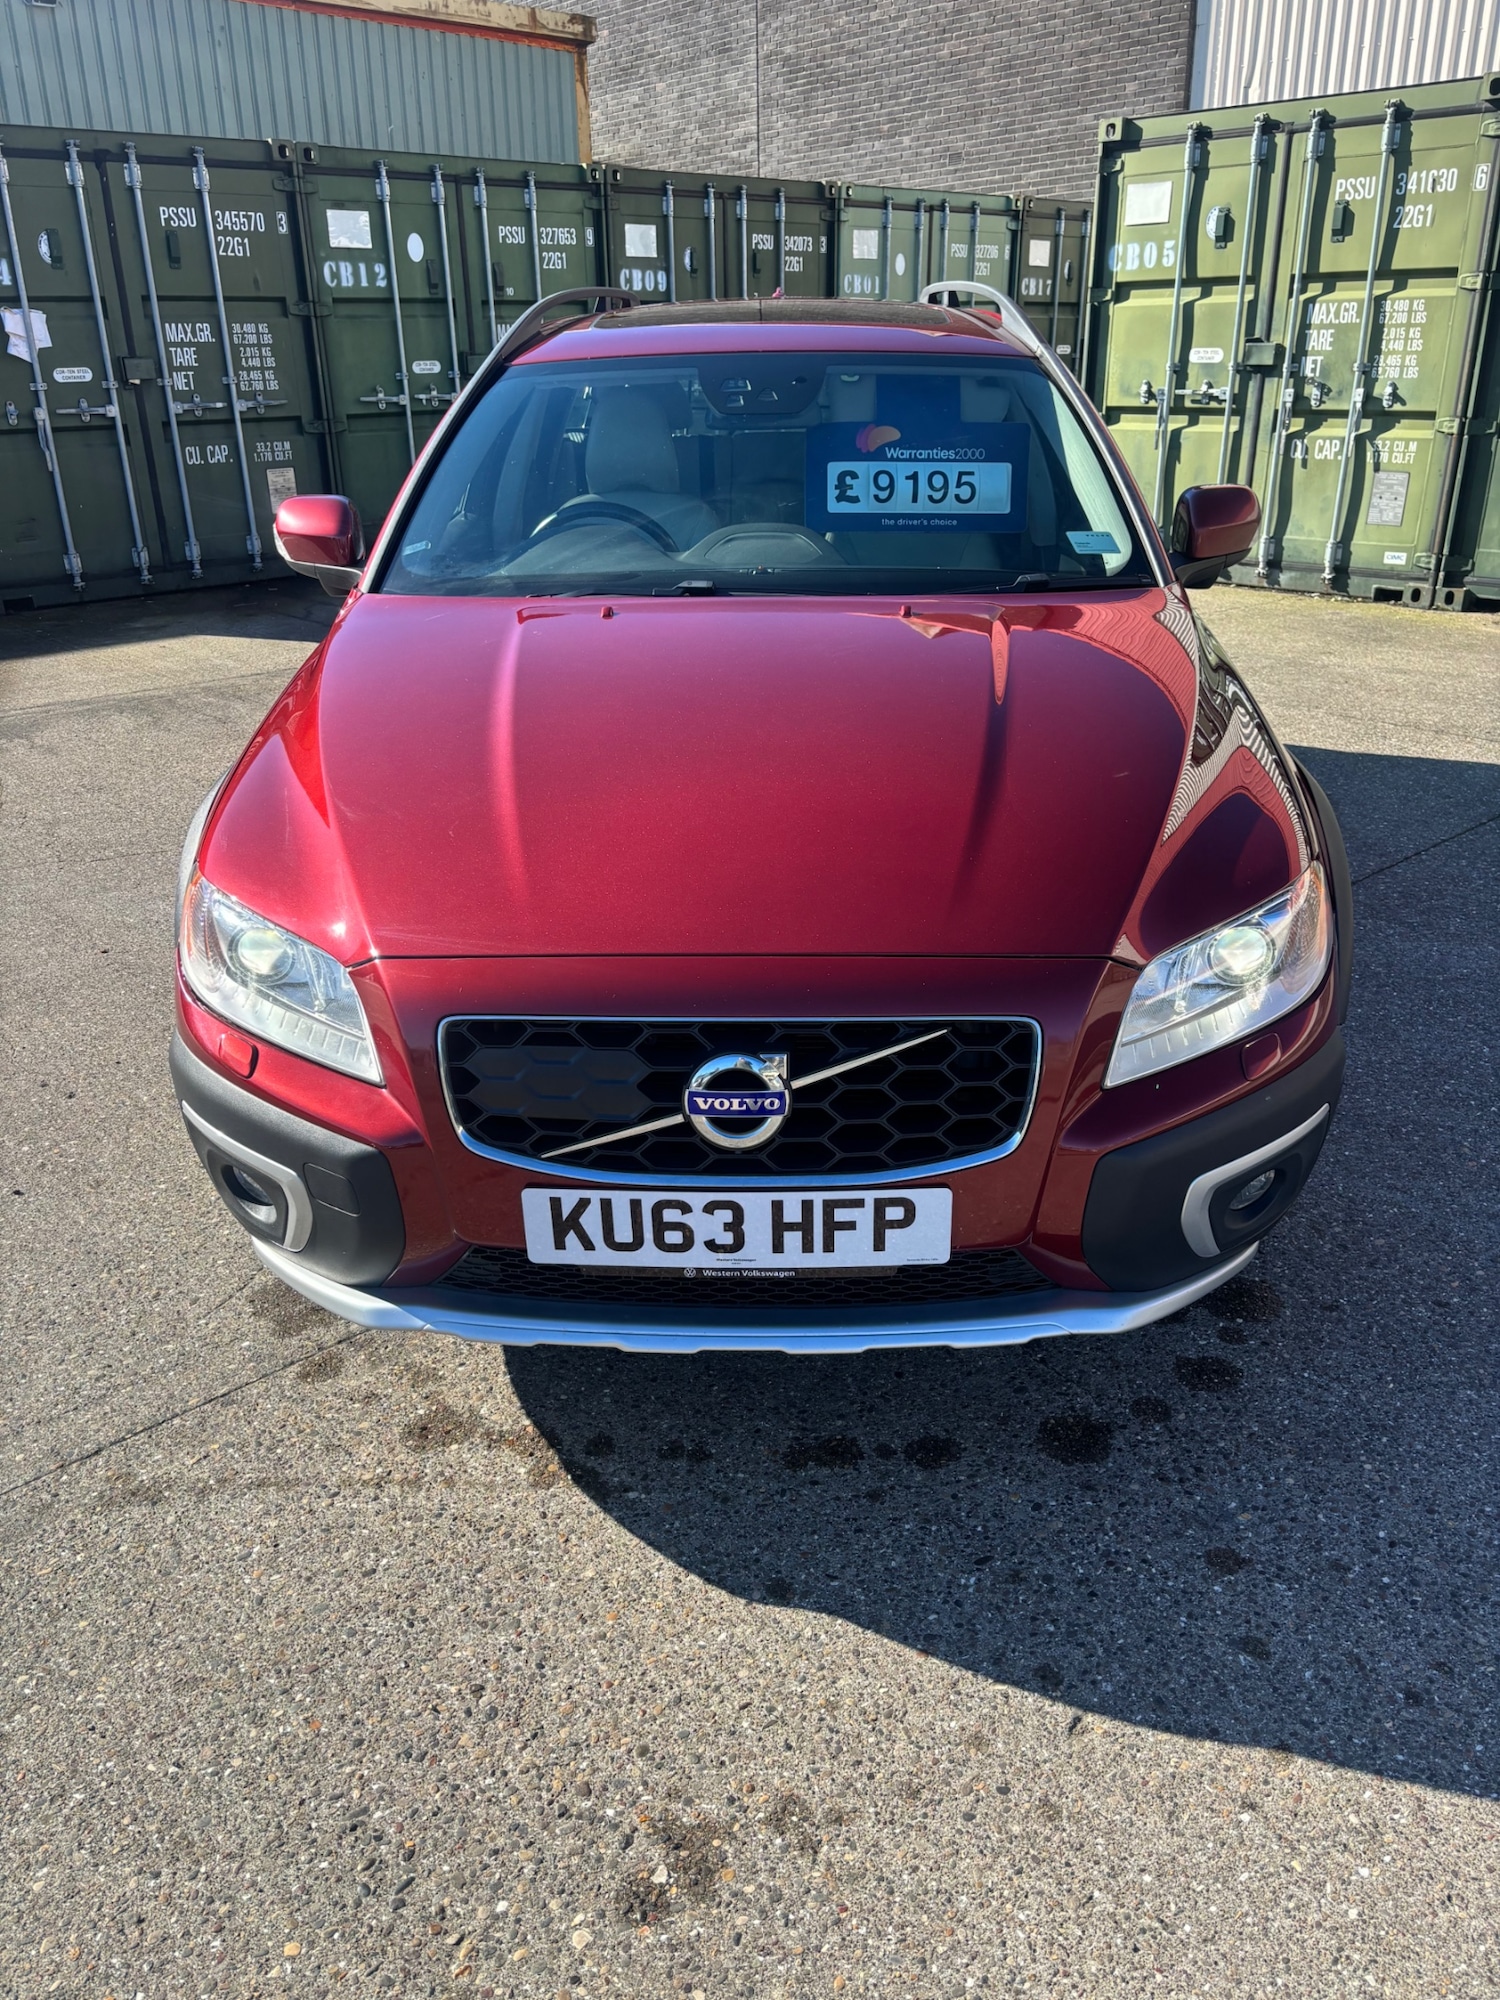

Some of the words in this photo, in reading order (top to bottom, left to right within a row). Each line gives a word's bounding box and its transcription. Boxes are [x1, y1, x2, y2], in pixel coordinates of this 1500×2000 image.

[1335, 176, 1376, 200] PSSU
[1475, 165, 1489, 190] 6
[159, 206, 197, 228] PSSU
[215, 210, 265, 232] 345570
[277, 211, 288, 234] 3
[1393, 204, 1434, 228] 22G1
[498, 225, 526, 244] PSSU
[540, 227, 577, 245] 327653
[586, 228, 594, 246] 9
[752, 233, 774, 250] PSSU
[785, 235, 813, 251] 342073
[820, 236, 827, 253] 3
[218, 235, 250, 257] 22G1
[950, 243, 968, 258] PSSU
[1108, 240, 1176, 272] CB05
[542, 251, 567, 269] 22G1
[785, 256, 804, 272] 22G1
[323, 261, 387, 288] CB12
[619, 268, 668, 292] CB09
[843, 274, 880, 295] CB01
[1021, 277, 1052, 297] CB17
[1307, 301, 1360, 324] MAX.GR.
[1413, 299, 1425, 311] KG
[1411, 312, 1427, 324] LBS
[165, 322, 215, 343] MAX.GR.
[258, 323, 269, 333] KG
[260, 334, 273, 344] LBS
[1305, 329, 1335, 351] TARE
[1409, 327, 1421, 339] KG
[1407, 340, 1423, 352] LBS
[169, 347, 199, 367] TARE
[261, 347, 272, 357] KG
[263, 357, 276, 367] LBS
[1300, 356, 1324, 378] NET
[1405, 354, 1417, 366] KG
[172, 371, 195, 391] NET
[264, 370, 275, 380] KG
[1403, 366, 1419, 379] LBS
[266, 380, 279, 390] LBS
[185, 446, 204, 465] CU.
[885, 447, 985, 460] Warranties2000
[1314, 439, 1342, 460] CAP.
[834, 469, 977, 504] £9195
[881, 518, 895, 526] the
[897, 517, 928, 526] driver's
[930, 518, 957, 526] choice
[693, 1097, 780, 1111] VOLVO
[549, 1196, 745, 1254] KU63
[771, 1196, 917, 1254] HFP
[702, 1269, 740, 1277] Western
[741, 1269, 796, 1279] Volkswagen
